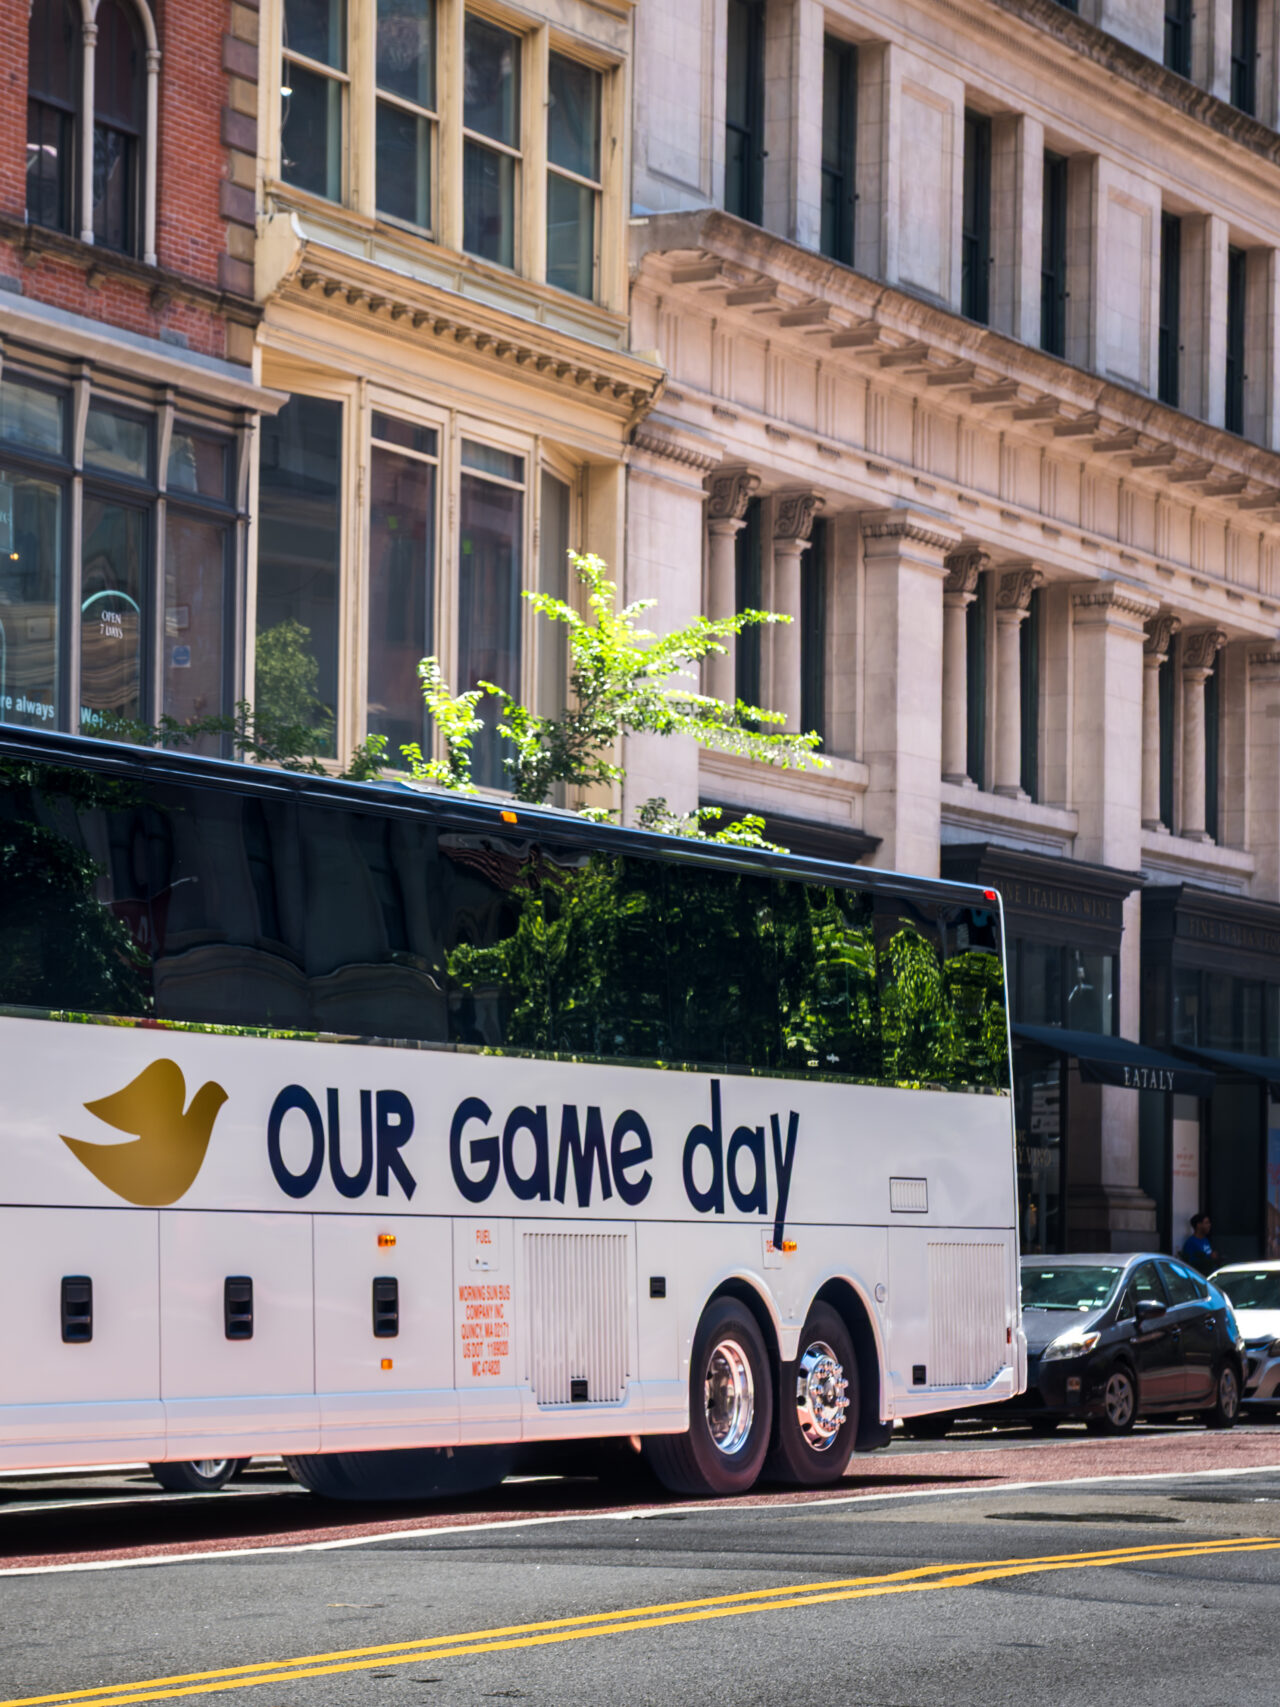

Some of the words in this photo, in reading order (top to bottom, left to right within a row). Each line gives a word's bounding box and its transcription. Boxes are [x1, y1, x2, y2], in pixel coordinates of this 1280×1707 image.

[101, 610, 122, 625] OPEN
[105, 626, 124, 640] DAYS
[15, 696, 55, 721] always
[1123, 1066, 1175, 1091] EATALY
[267, 1084, 418, 1201] OUR
[682, 1078, 800, 1251] day
[476, 1229, 492, 1245] FUEL
[458, 1285, 485, 1302] MORNING
[486, 1285, 498, 1301] SUN
[498, 1284, 511, 1301] BUS
[465, 1303, 493, 1321] COMPANY
[494, 1303, 504, 1319] INC
[484, 1322, 493, 1338] MA
[472, 1360, 481, 1377] MC
